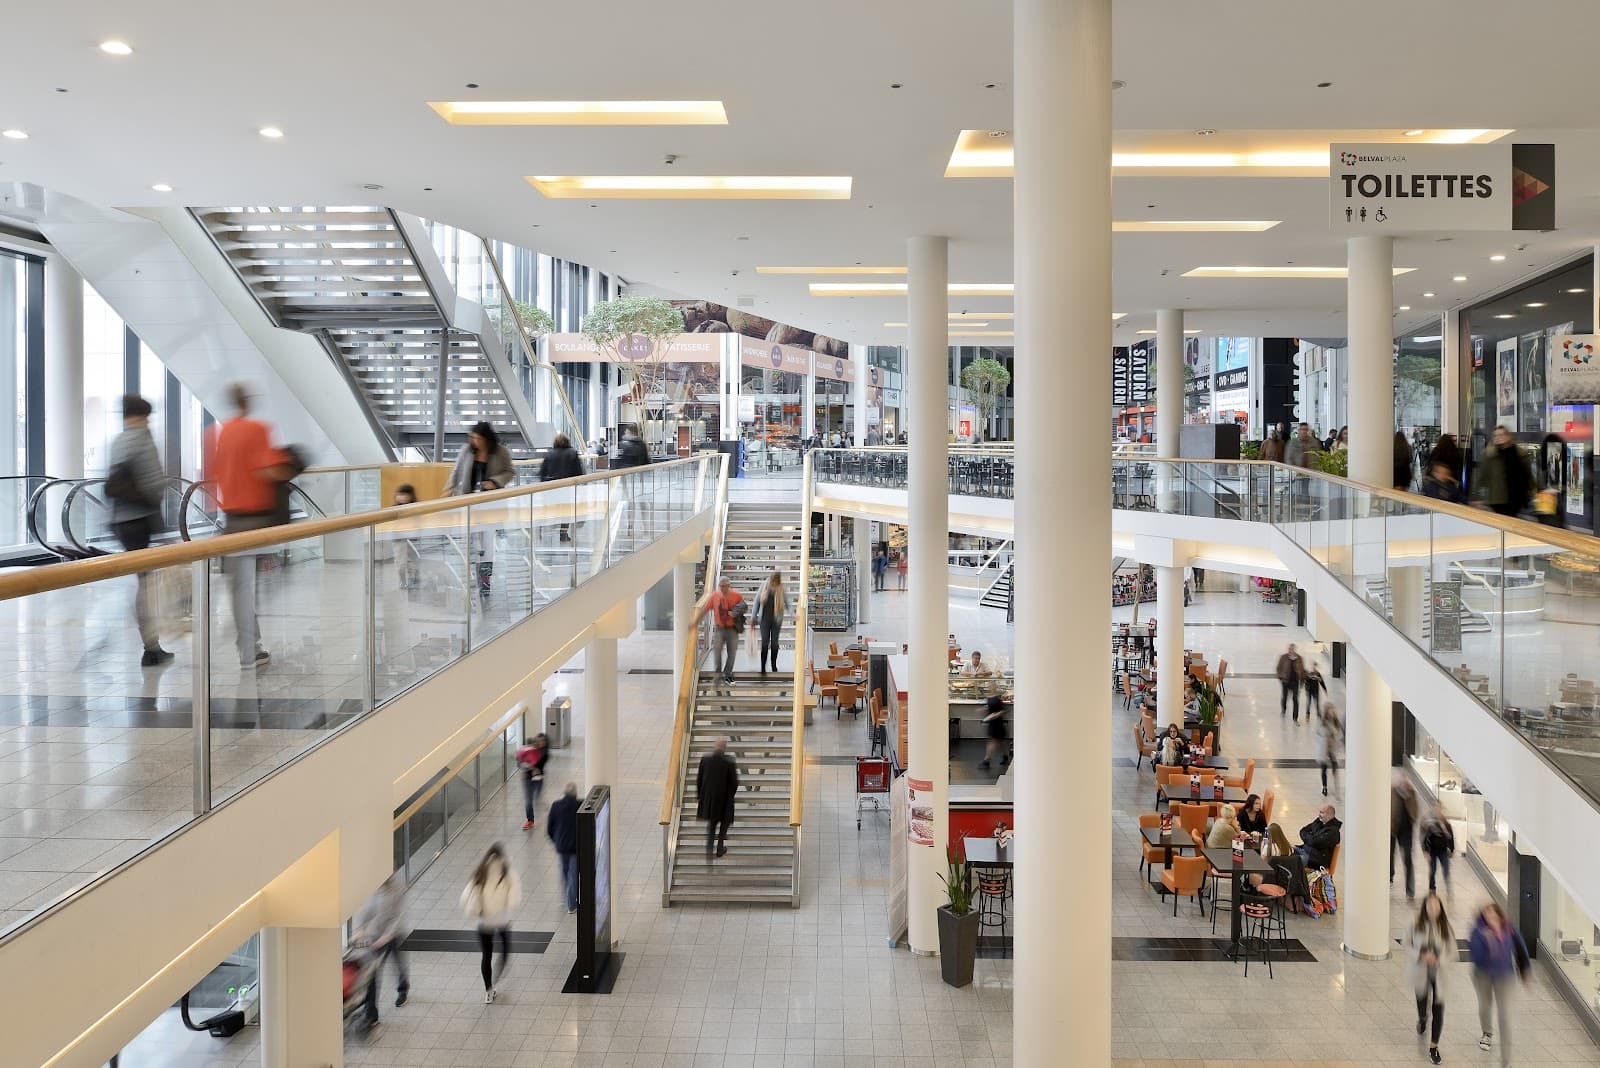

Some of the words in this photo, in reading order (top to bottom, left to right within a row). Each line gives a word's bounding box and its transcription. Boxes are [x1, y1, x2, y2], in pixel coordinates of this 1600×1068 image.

[1341, 174, 1493, 199] TOILETTES
[1114, 358, 1127, 404] SATURN
[1132, 349, 1147, 400] SATURN
[1229, 371, 1247, 385] GAMING
